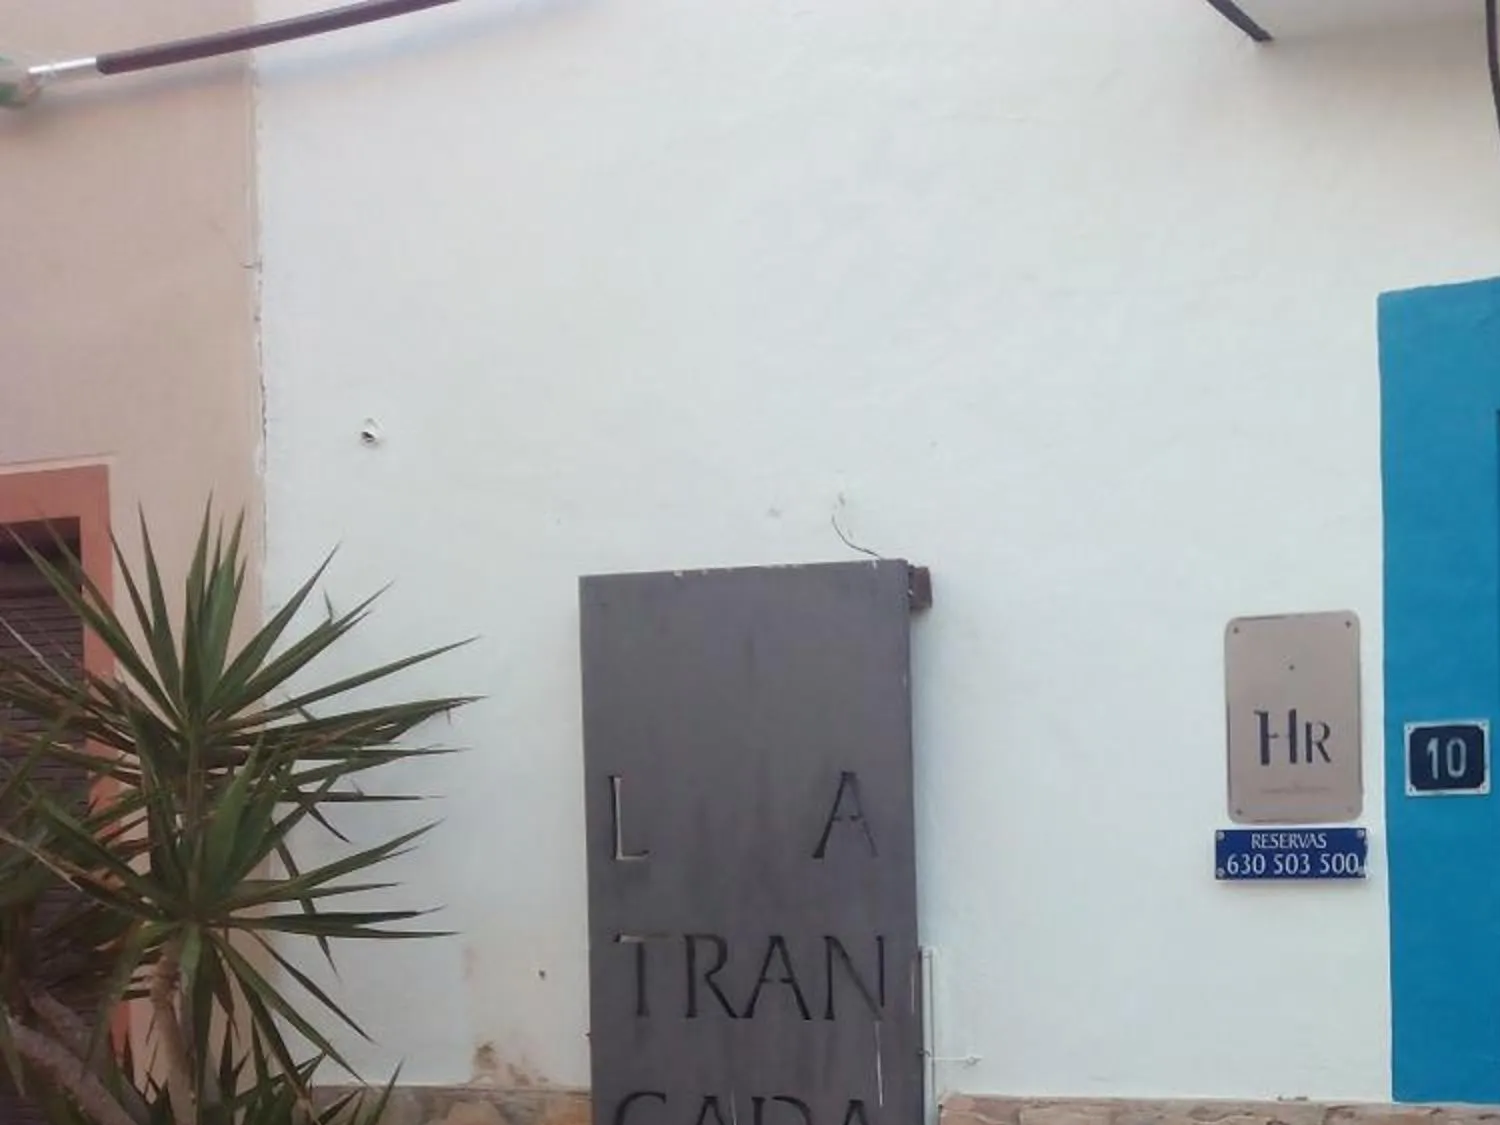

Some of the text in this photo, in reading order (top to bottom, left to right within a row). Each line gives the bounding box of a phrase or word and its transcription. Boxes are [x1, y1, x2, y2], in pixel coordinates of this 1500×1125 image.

[1426, 737, 1467, 780] 10
[1251, 832, 1327, 850] RESERVAS
[1226, 852, 1359, 875] 630 503 500
[612, 932, 887, 1022] TRAN
